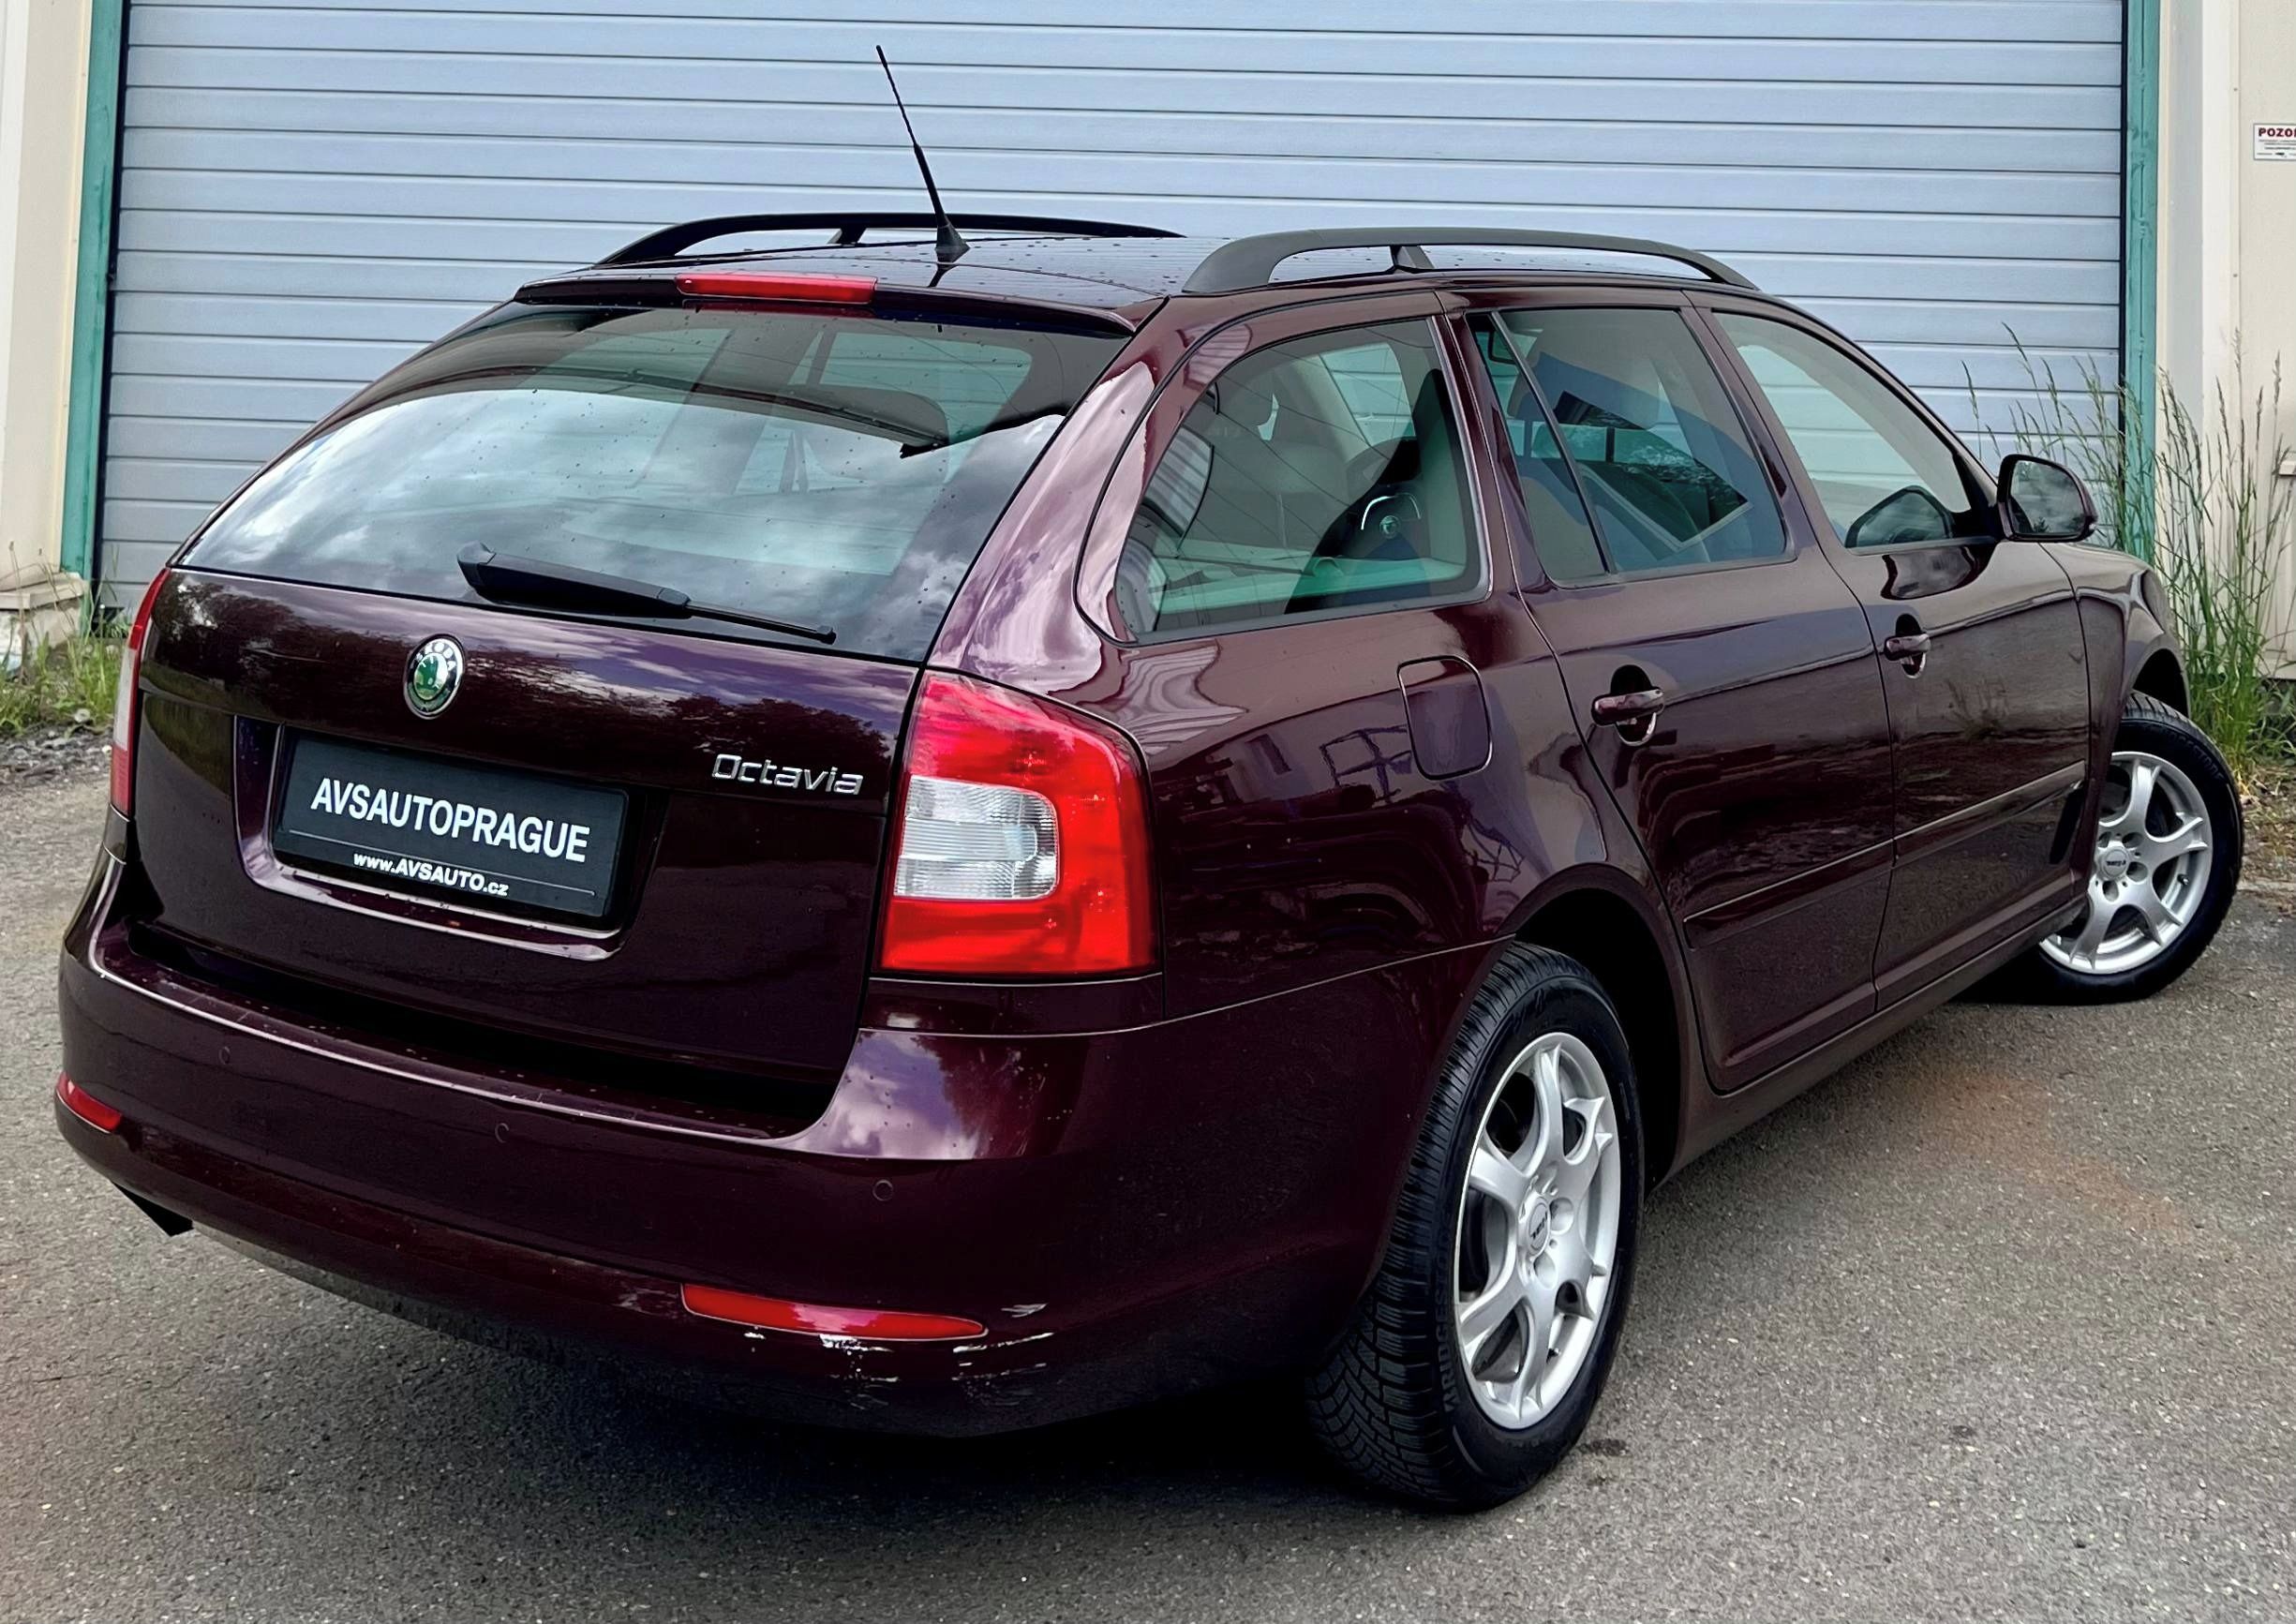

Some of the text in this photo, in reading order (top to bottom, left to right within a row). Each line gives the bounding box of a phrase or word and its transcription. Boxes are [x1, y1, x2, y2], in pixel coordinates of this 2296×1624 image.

[2259, 127, 2296, 138] POZO
[711, 752, 864, 796] Octavia
[310, 777, 591, 863] AVSAUTOPRAGUE
[353, 853, 509, 896] www.AVSAUTO.cz
